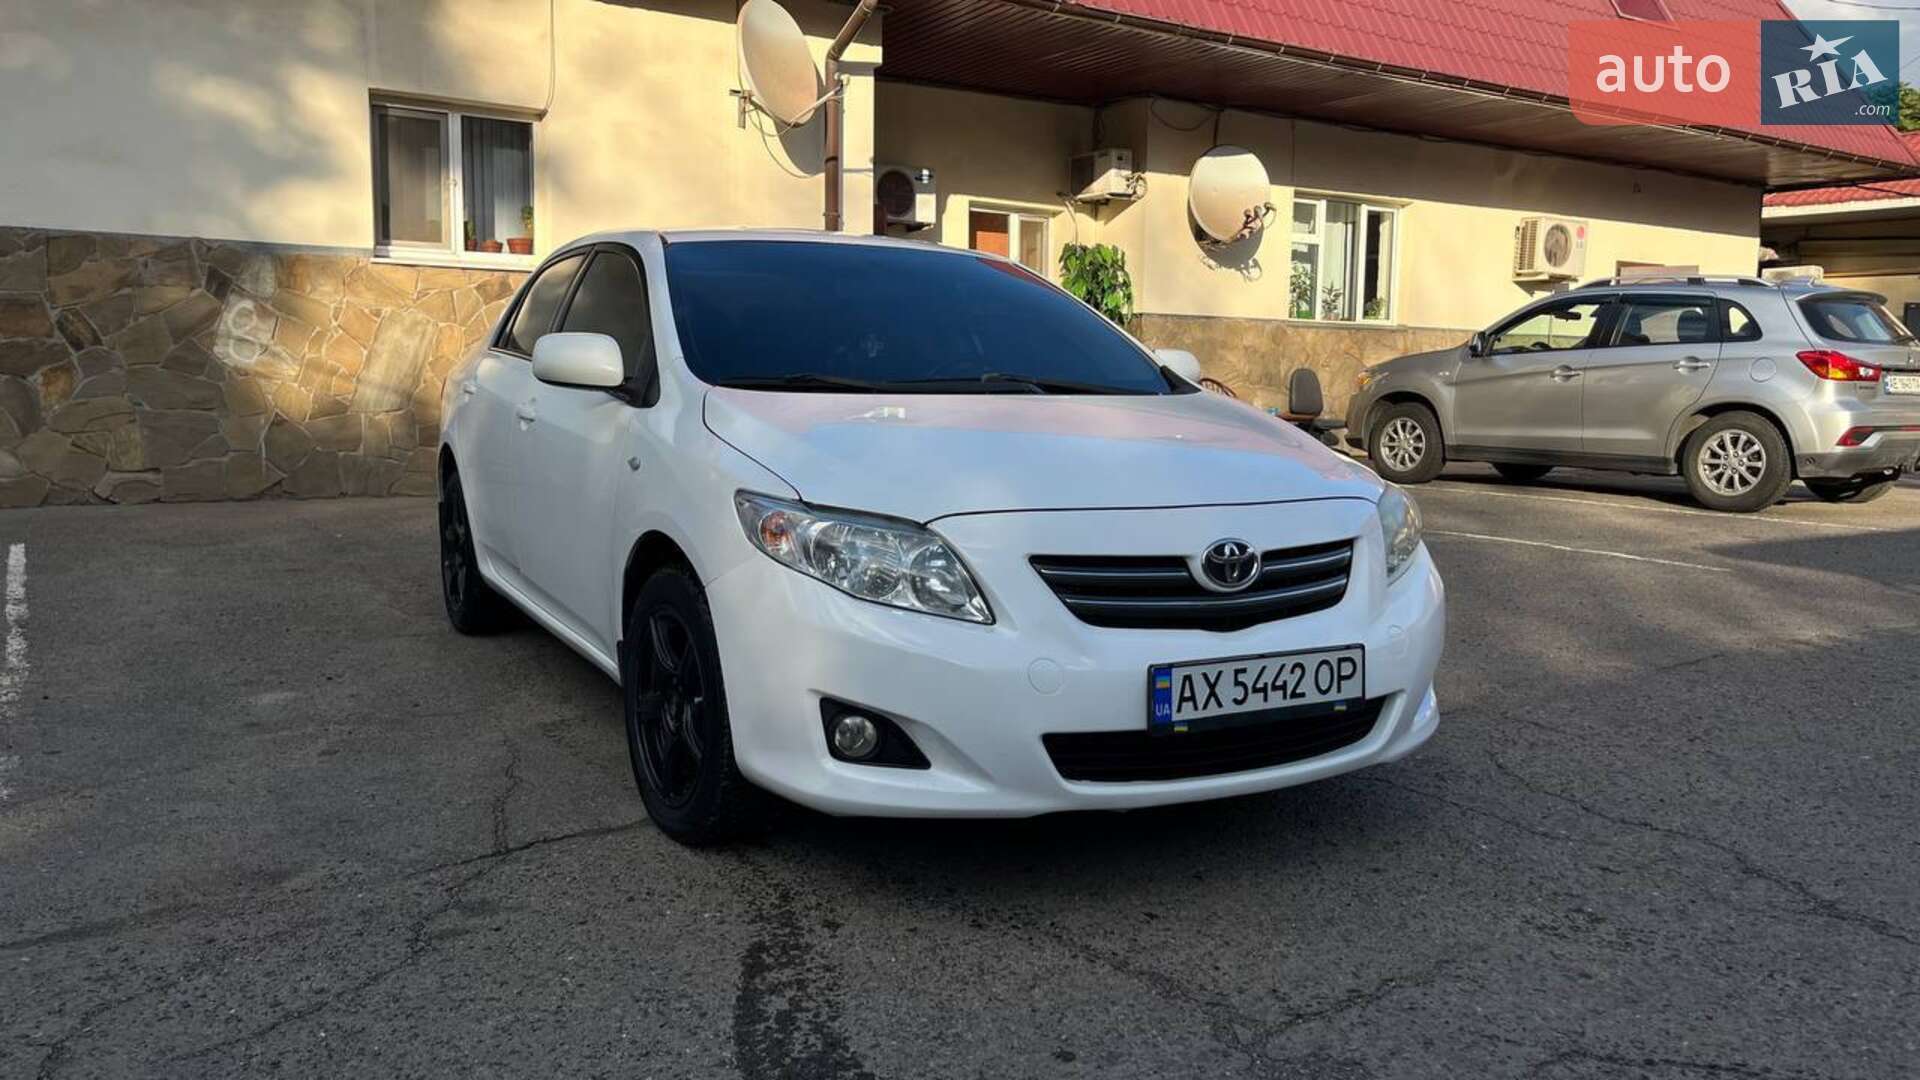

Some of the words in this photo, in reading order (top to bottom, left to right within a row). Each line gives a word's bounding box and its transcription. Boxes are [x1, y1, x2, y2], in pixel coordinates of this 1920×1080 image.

[1176, 670, 1224, 714] AX
[1232, 662, 1307, 706] 5442
[1314, 656, 1358, 696] OP
[1155, 703, 1171, 717] UA
